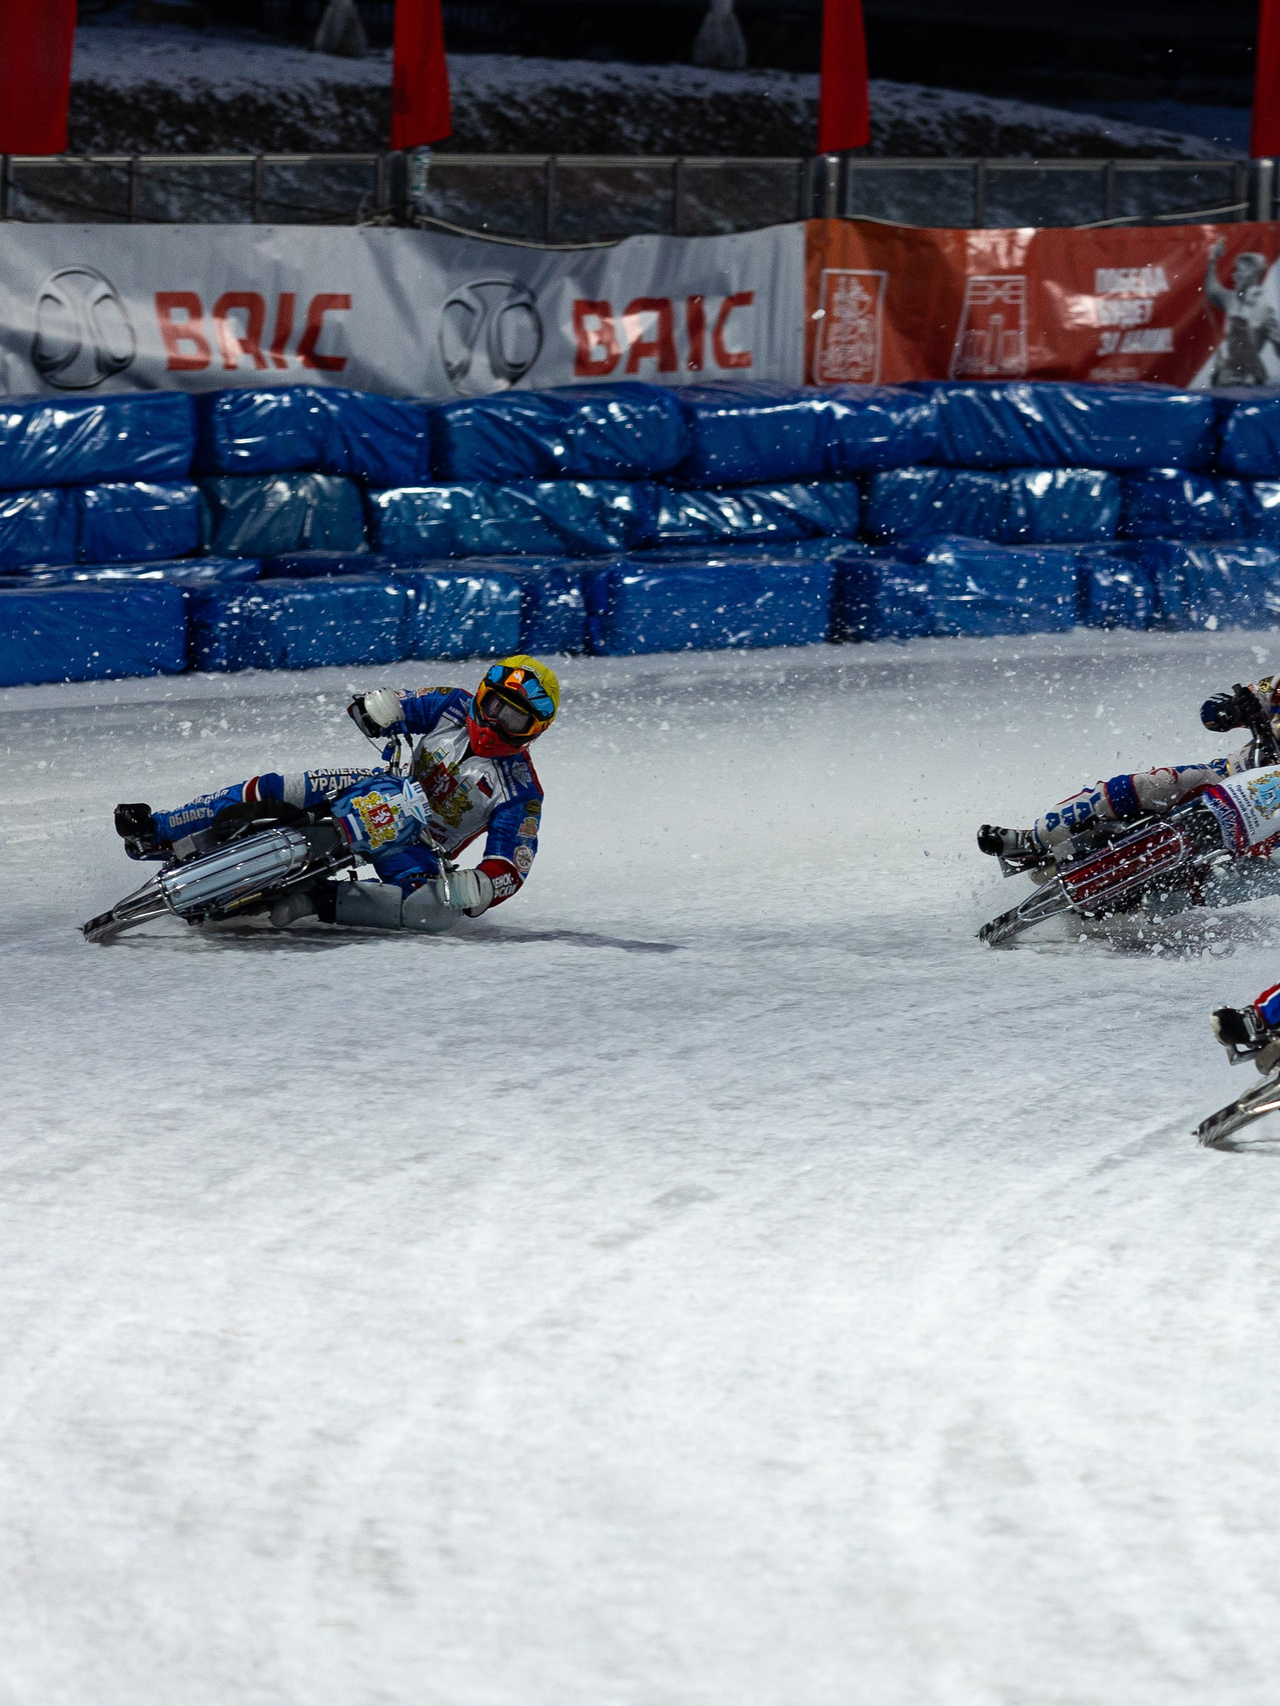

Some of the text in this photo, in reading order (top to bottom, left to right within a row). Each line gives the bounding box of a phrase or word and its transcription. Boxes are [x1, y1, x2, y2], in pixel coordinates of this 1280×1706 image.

[153, 291, 353, 371] BAIC
[571, 291, 756, 377] BAIC
[168, 807, 215, 828] ОБЛАСТЬ
